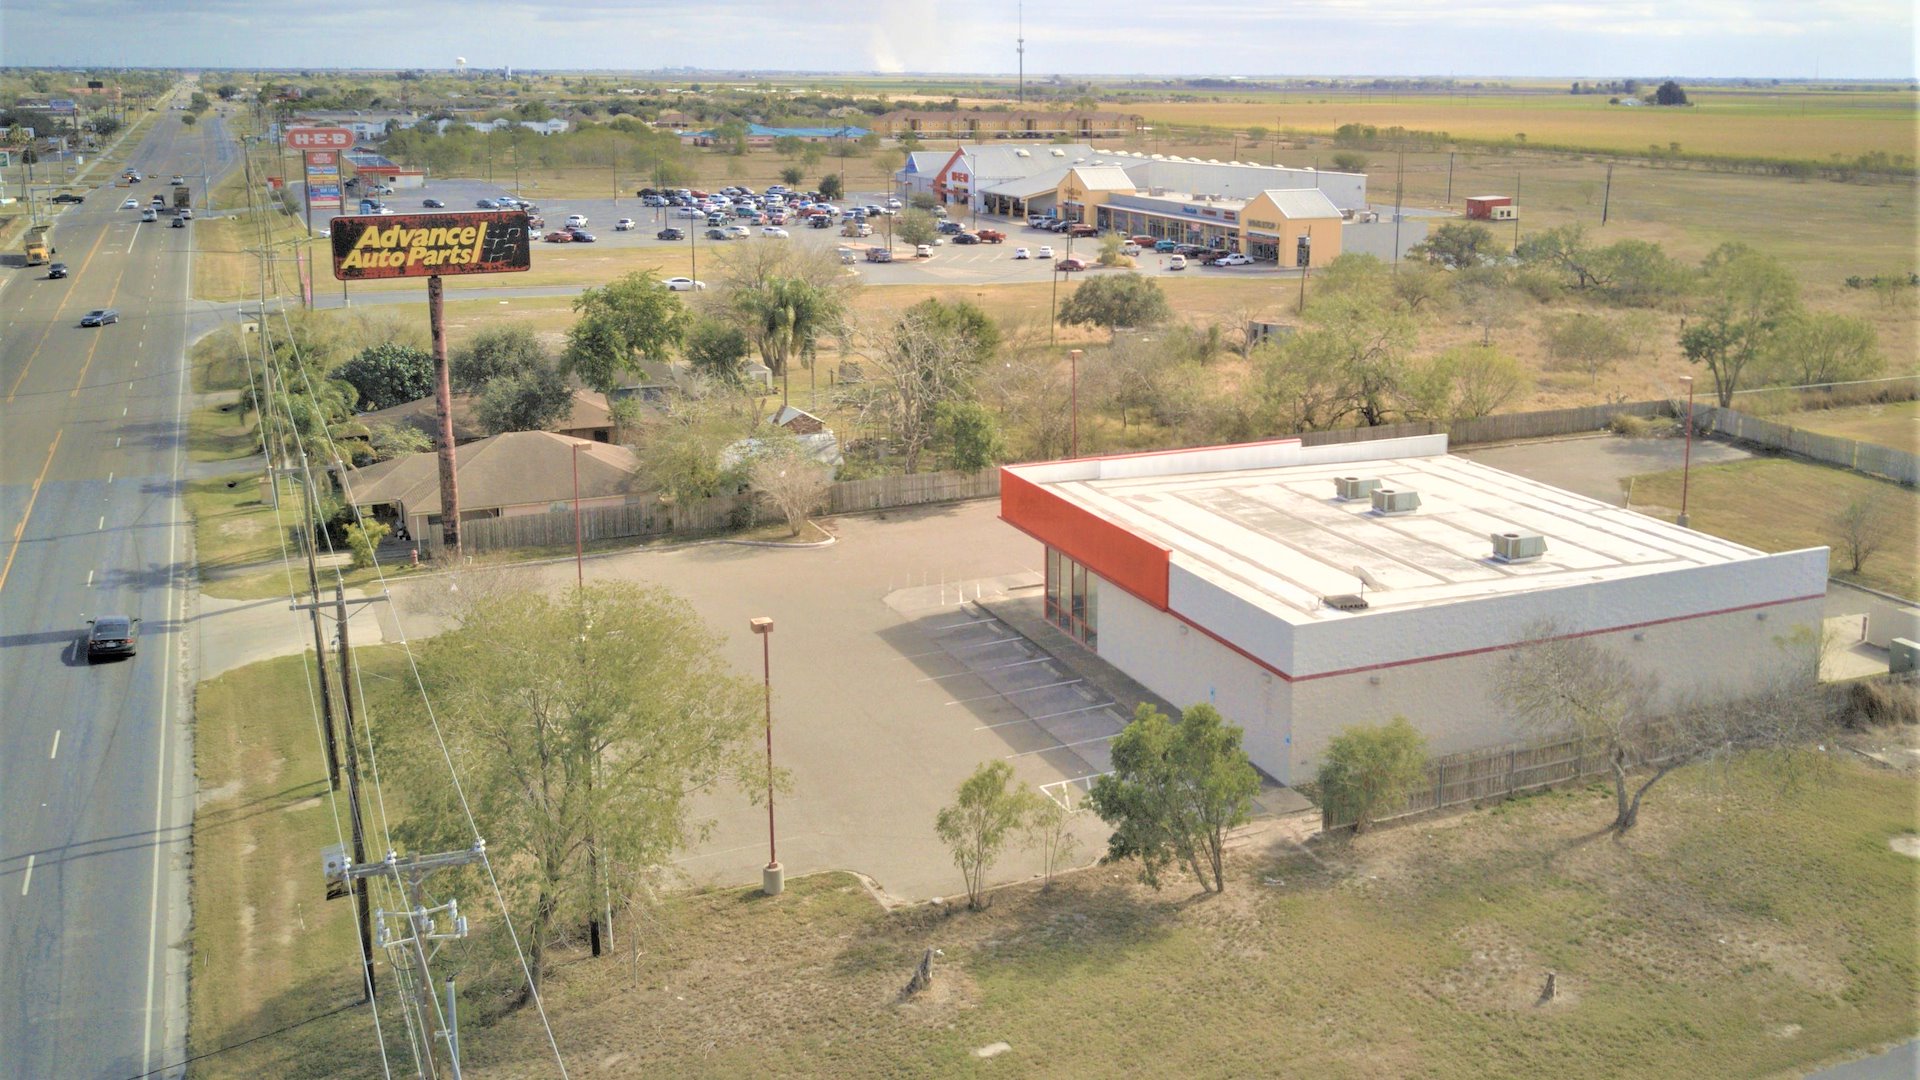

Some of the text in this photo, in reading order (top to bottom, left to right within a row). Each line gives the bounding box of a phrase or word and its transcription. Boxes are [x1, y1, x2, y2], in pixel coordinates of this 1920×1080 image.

[355, 225, 475, 248] Advance
[341, 246, 472, 269] Auto Parts
